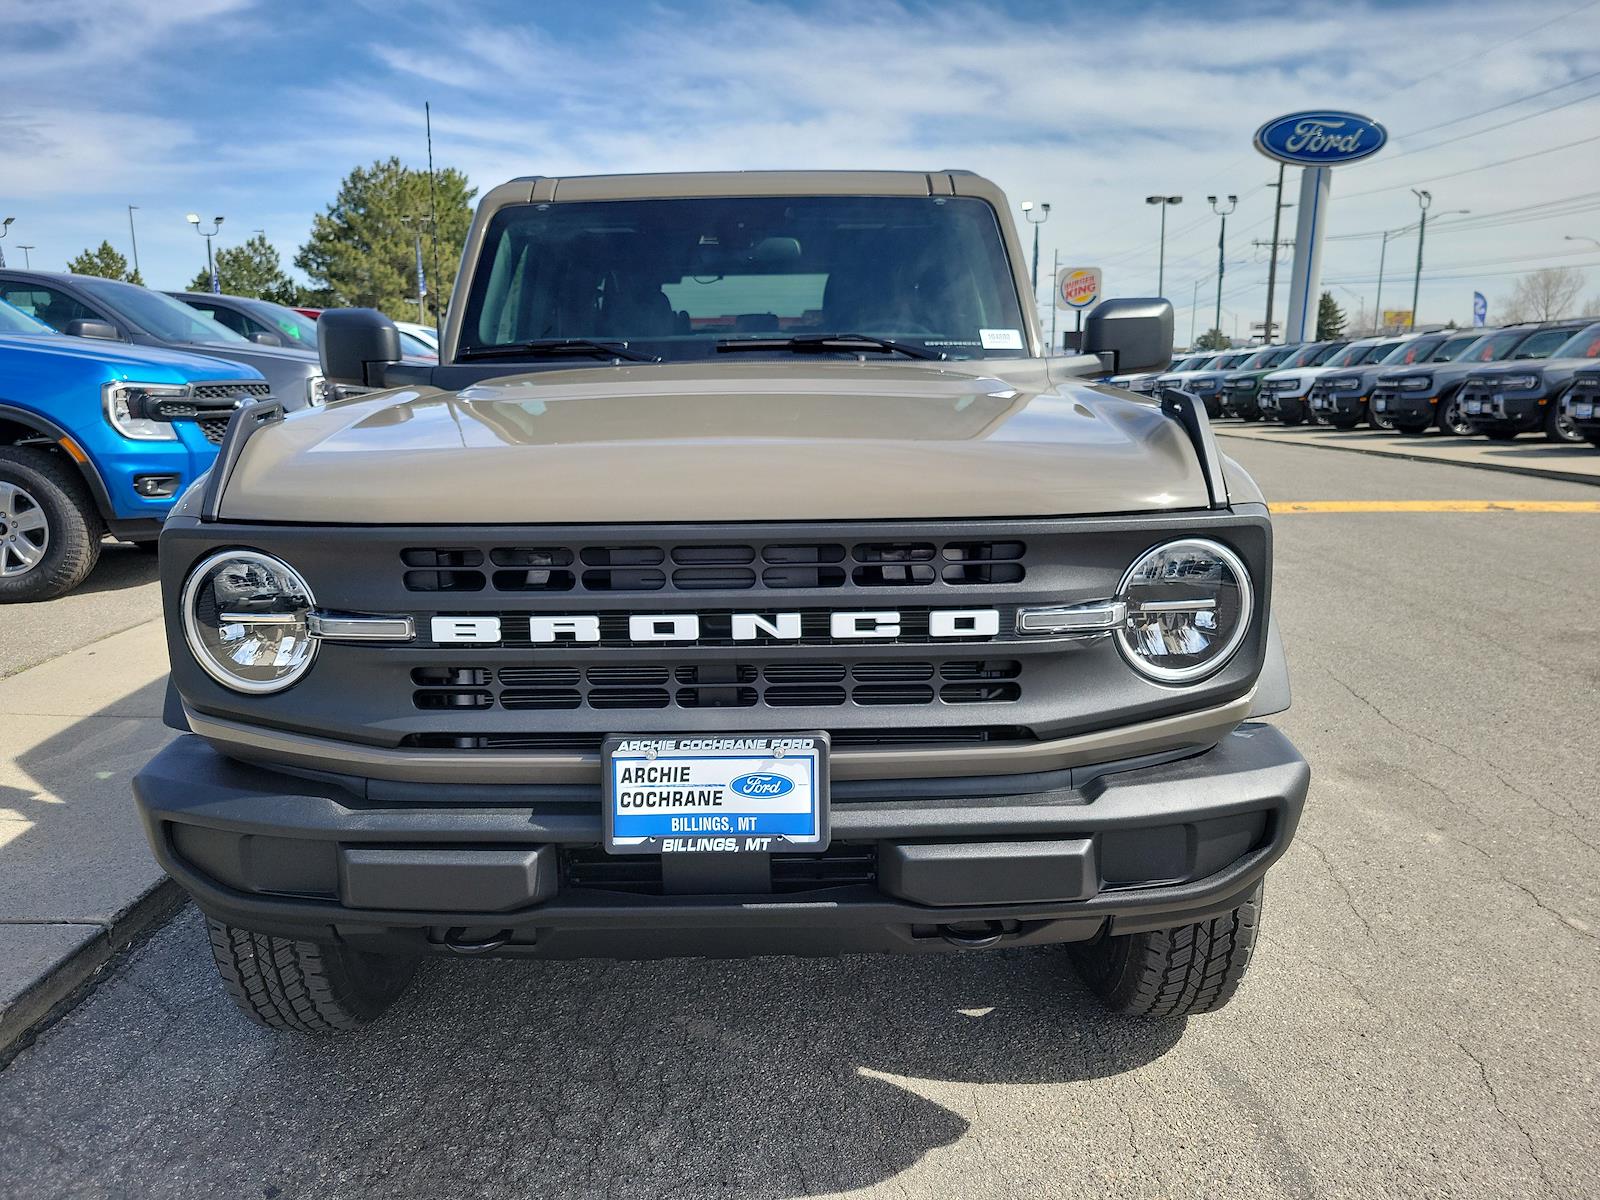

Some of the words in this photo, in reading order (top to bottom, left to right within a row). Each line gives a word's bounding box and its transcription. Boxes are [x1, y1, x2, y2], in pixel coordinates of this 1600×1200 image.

[1285, 119, 1364, 153] Ford
[1065, 282, 1096, 300] KING
[431, 609, 999, 642] BRONCO
[617, 740, 675, 752] ARCHIE
[679, 739, 766, 751] COCHRANE
[770, 738, 815, 750] FORD
[620, 766, 691, 784] ARCHIE
[742, 775, 781, 795] Ford
[620, 790, 723, 808] COCHRANE
[671, 816, 734, 833] BILLINGS,
[737, 816, 758, 831] MT
[661, 837, 740, 853] BILLINGS,
[744, 837, 772, 851] MT
